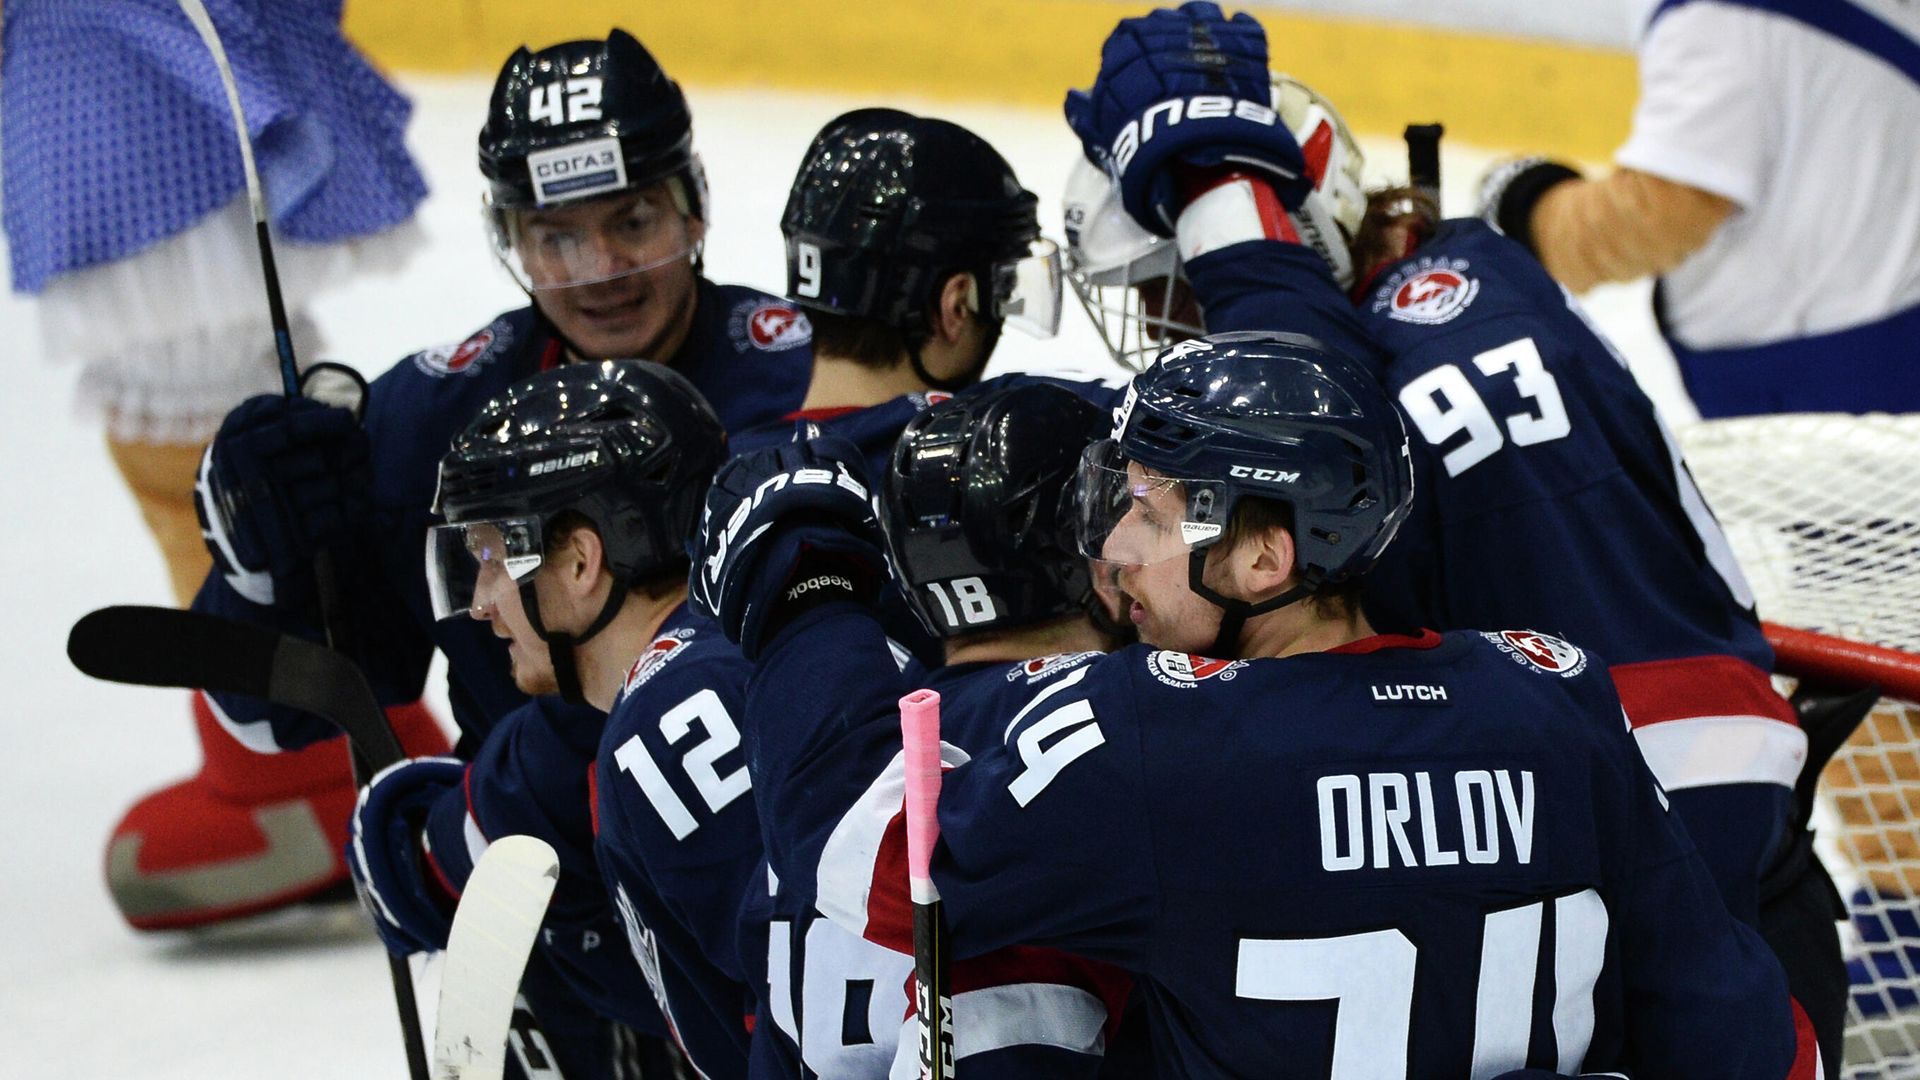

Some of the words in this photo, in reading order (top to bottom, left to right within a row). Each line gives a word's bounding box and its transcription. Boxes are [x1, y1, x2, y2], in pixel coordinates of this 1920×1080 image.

[529, 77, 602, 126] 42
[537, 151, 615, 177] СОГАЗ
[798, 242, 821, 298] 9
[1398, 337, 1571, 478] 93
[529, 450, 599, 477] BAUER
[1229, 464, 1301, 484] CCM
[1183, 524, 1220, 532] BAUER
[787, 575, 853, 601] Reebok
[926, 576, 997, 627] 18
[1371, 685, 1447, 701] LUTCH
[613, 688, 753, 842] 12
[1317, 769, 1535, 872] ORLOV
[1235, 888, 1609, 1080] 74
